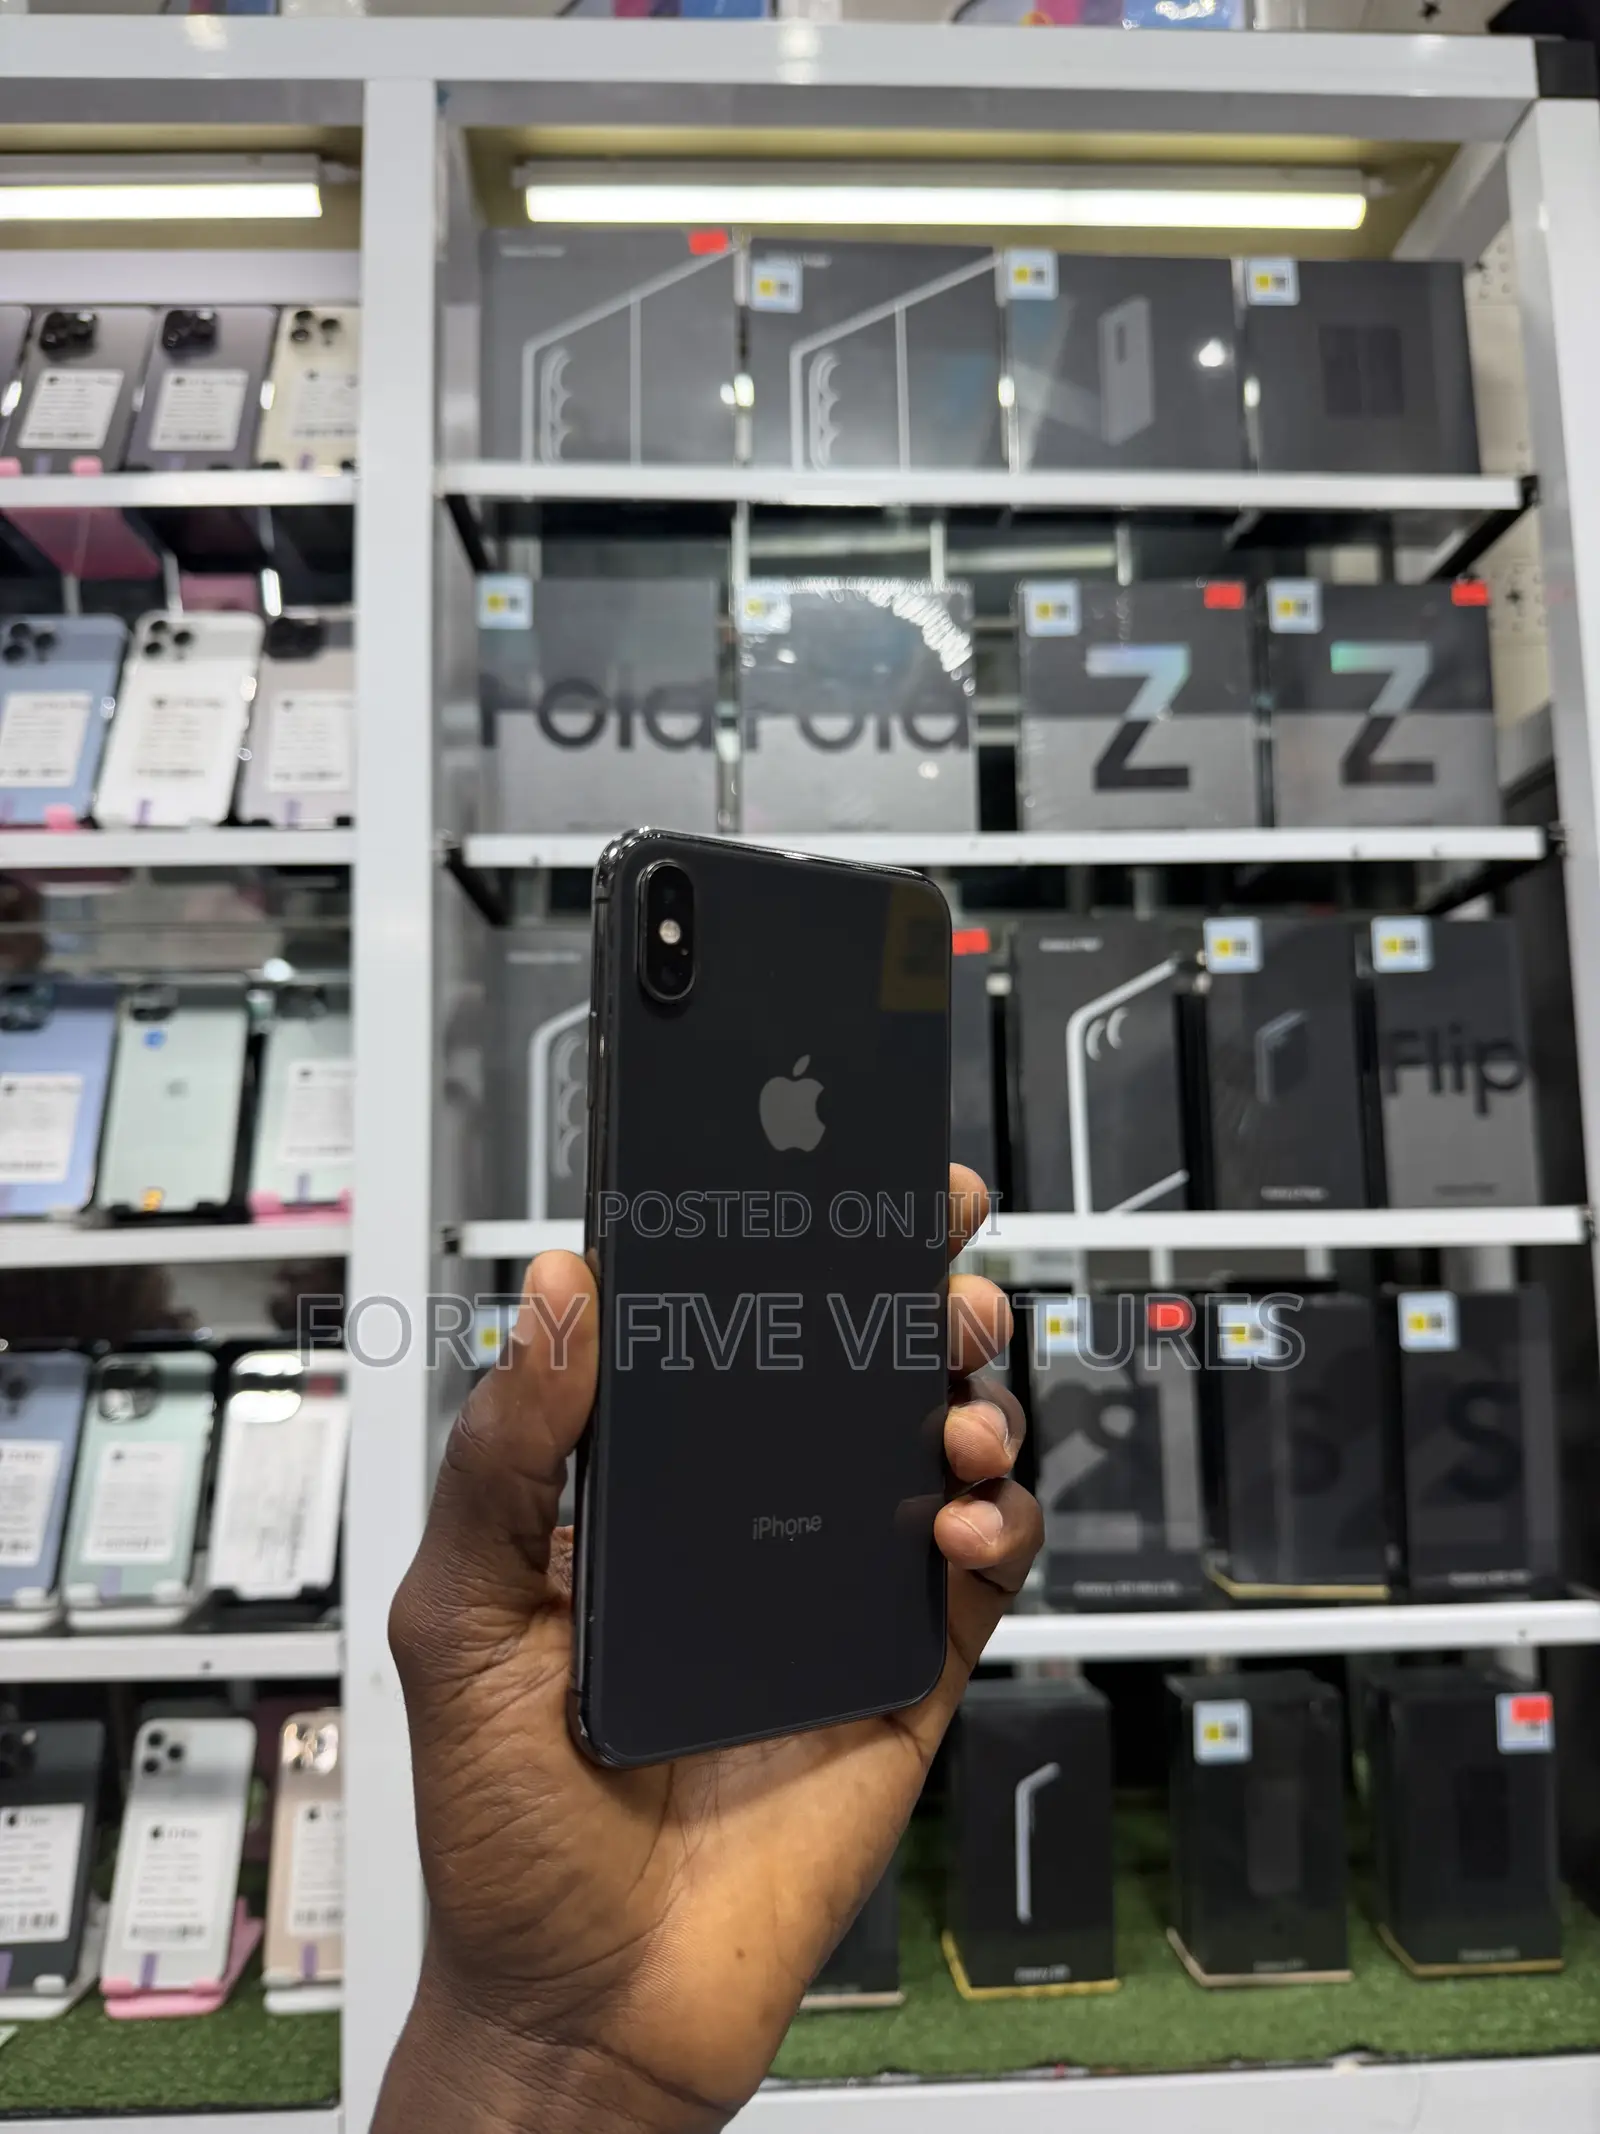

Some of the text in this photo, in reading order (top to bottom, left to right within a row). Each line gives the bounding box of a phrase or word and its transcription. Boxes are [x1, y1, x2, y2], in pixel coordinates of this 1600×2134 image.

[1086, 642, 1191, 791] Z
[1329, 640, 1436, 787] Z
[1382, 1022, 1527, 1119] Flip
[752, 1514, 823, 1541] iPhone
